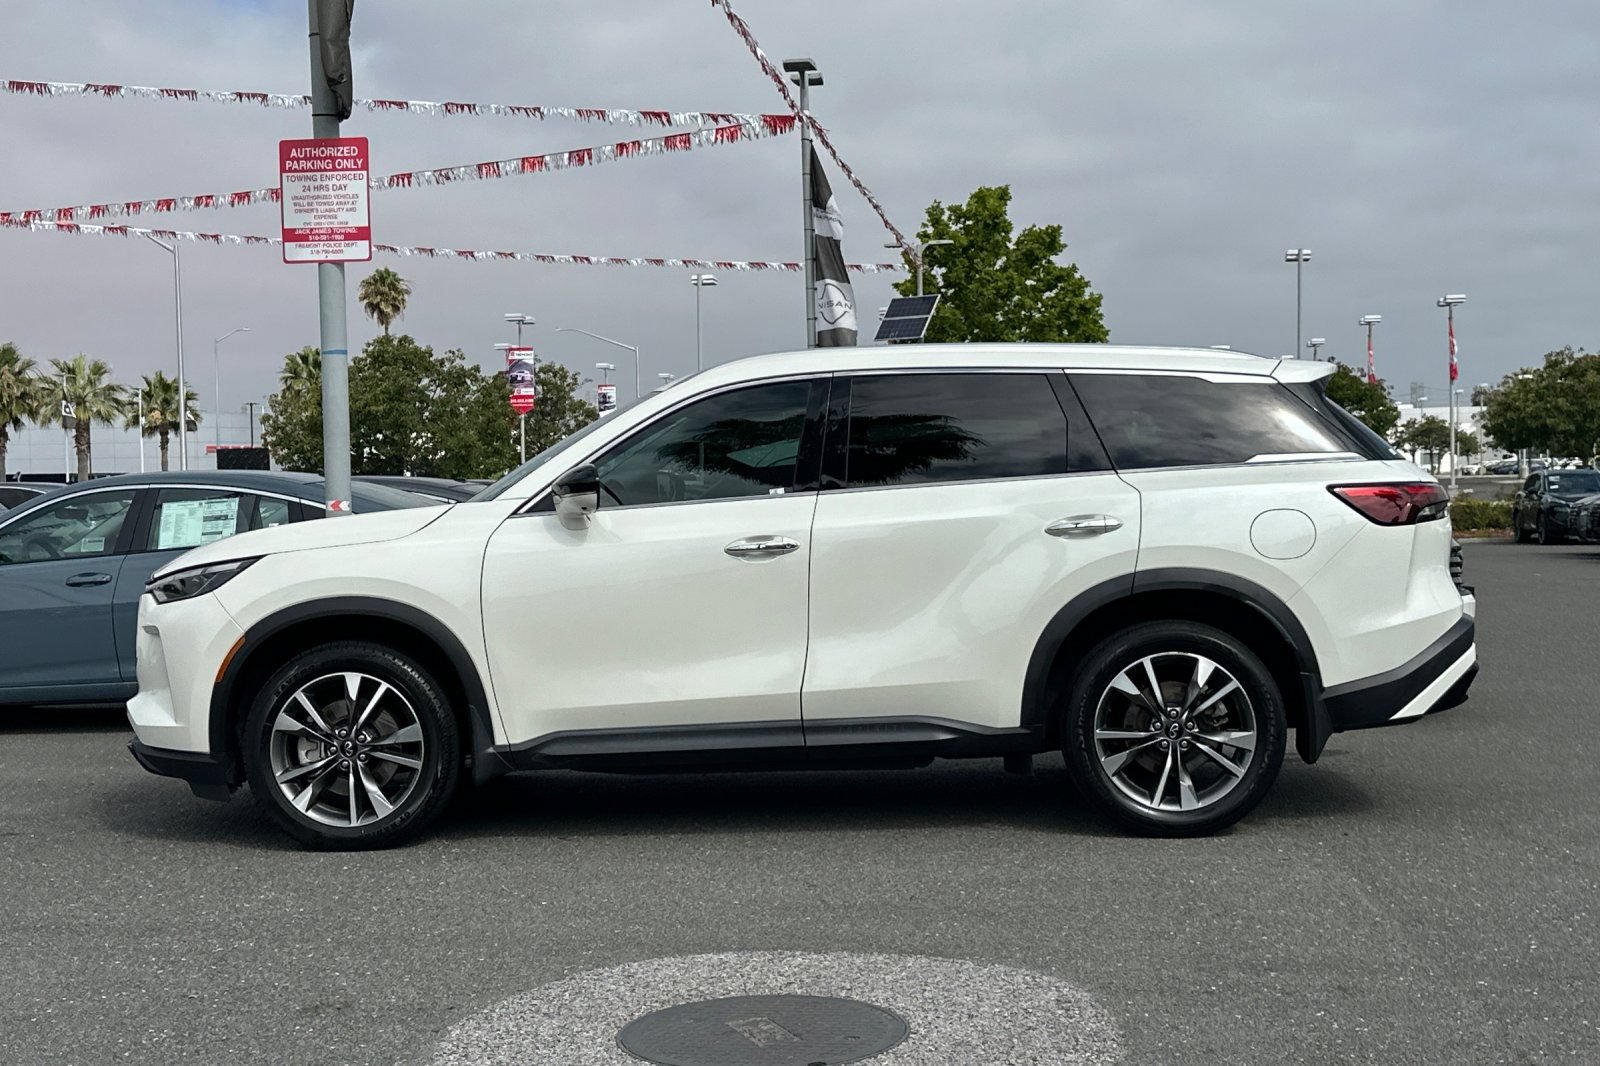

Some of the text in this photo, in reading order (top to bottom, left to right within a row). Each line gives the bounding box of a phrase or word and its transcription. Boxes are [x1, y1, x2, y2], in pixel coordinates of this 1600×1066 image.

[290, 146, 358, 158] AUTHORIZED
[286, 158, 363, 170] PARKING ONLY
[286, 173, 364, 183] TOWING ENFORCED
[313, 184, 329, 192] HRS
